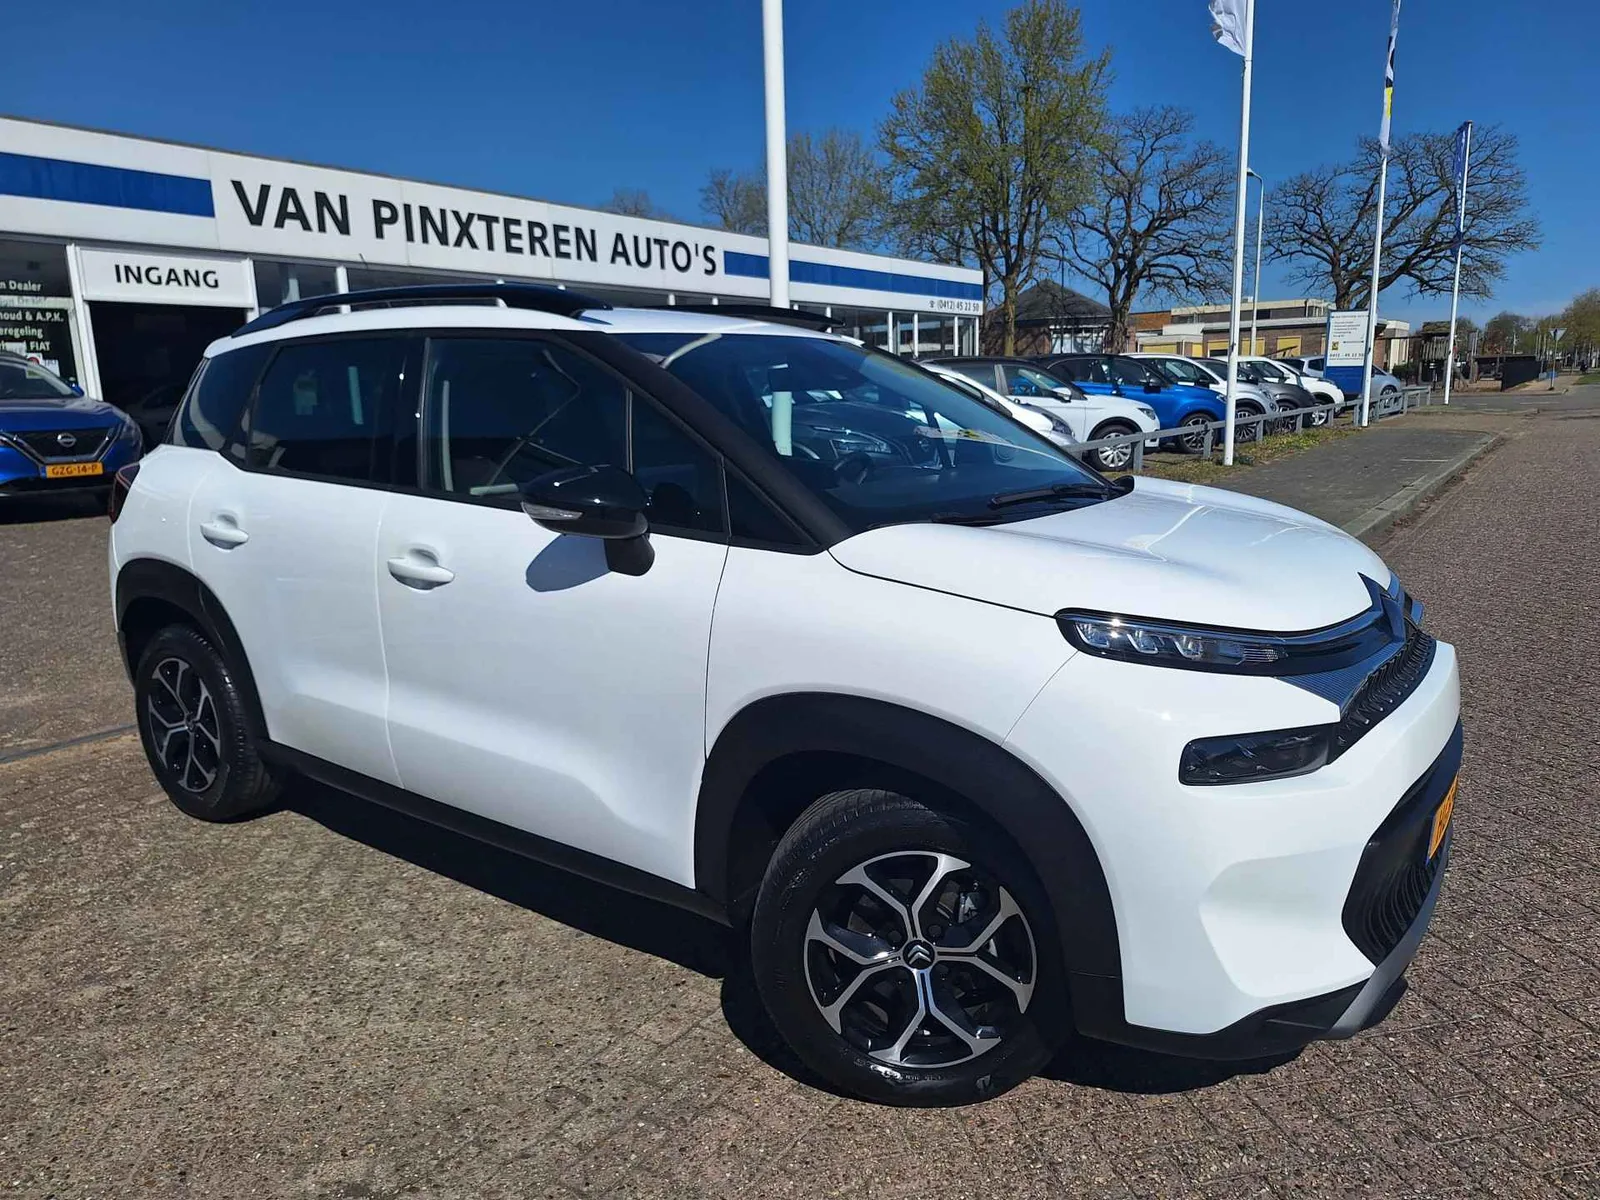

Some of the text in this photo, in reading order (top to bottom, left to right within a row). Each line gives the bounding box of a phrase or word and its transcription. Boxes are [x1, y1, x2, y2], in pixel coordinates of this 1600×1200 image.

[230, 180, 717, 276] VAN PINXTEREN AUTO'S
[114, 264, 219, 288] INGANG
[9, 280, 41, 291] Dealer
[937, 299, 980, 312] (0412) 45 22 50
[25, 311, 33, 321] &
[36, 311, 64, 322] A.P.K.
[30, 341, 51, 351] FIAT
